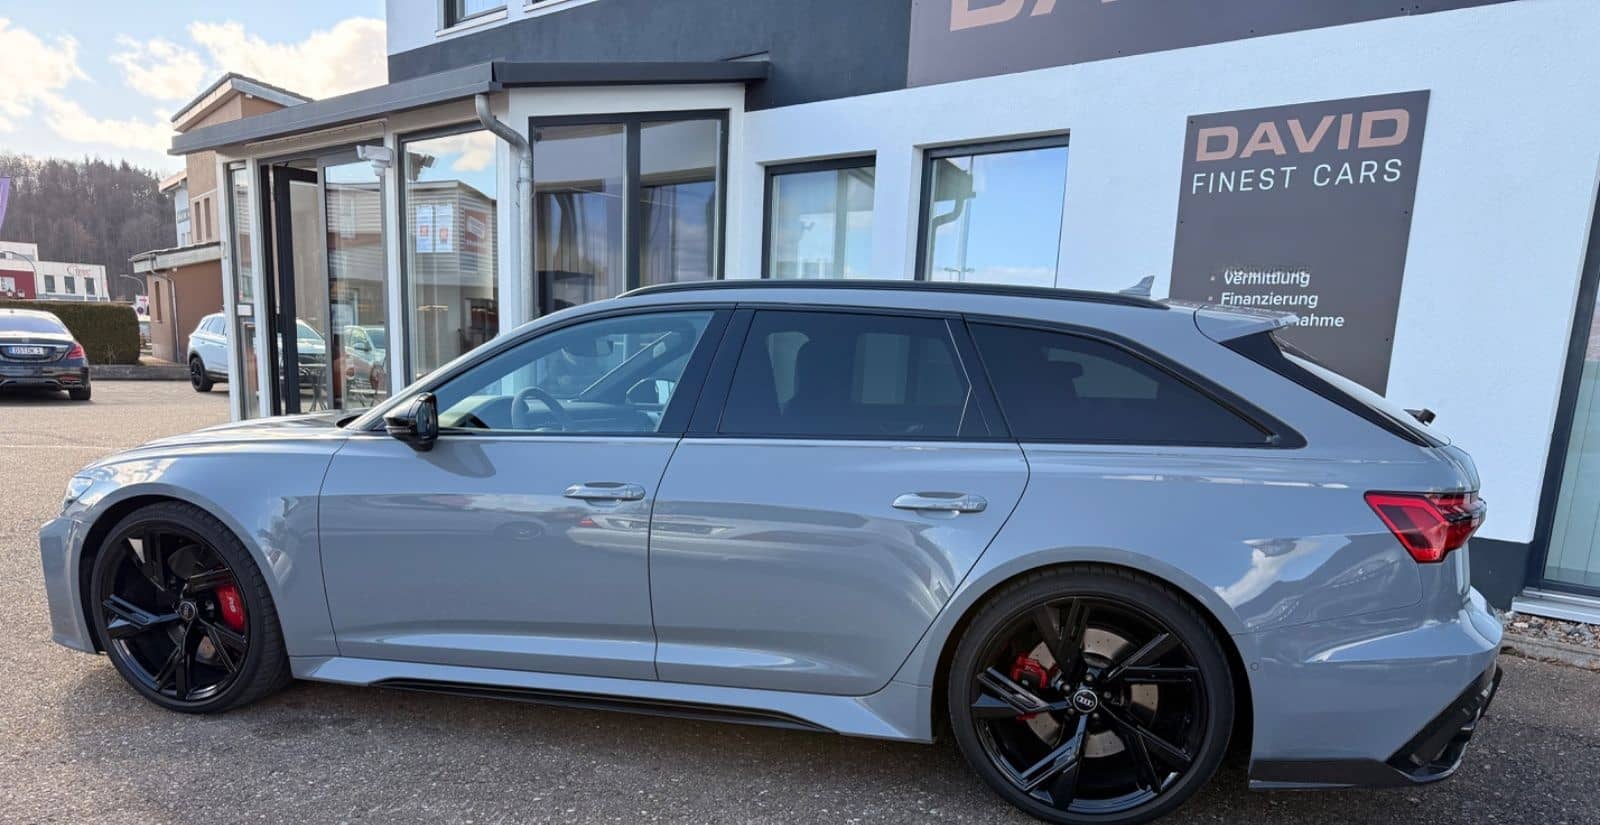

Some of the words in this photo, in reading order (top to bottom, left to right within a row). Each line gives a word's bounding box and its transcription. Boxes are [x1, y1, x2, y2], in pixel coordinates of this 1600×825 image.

[1196, 109, 1409, 162] DAVID
[1192, 166, 1297, 194] FINEST
[1313, 159, 1402, 186] CARS
[1220, 292, 1318, 308] Finanzierung
